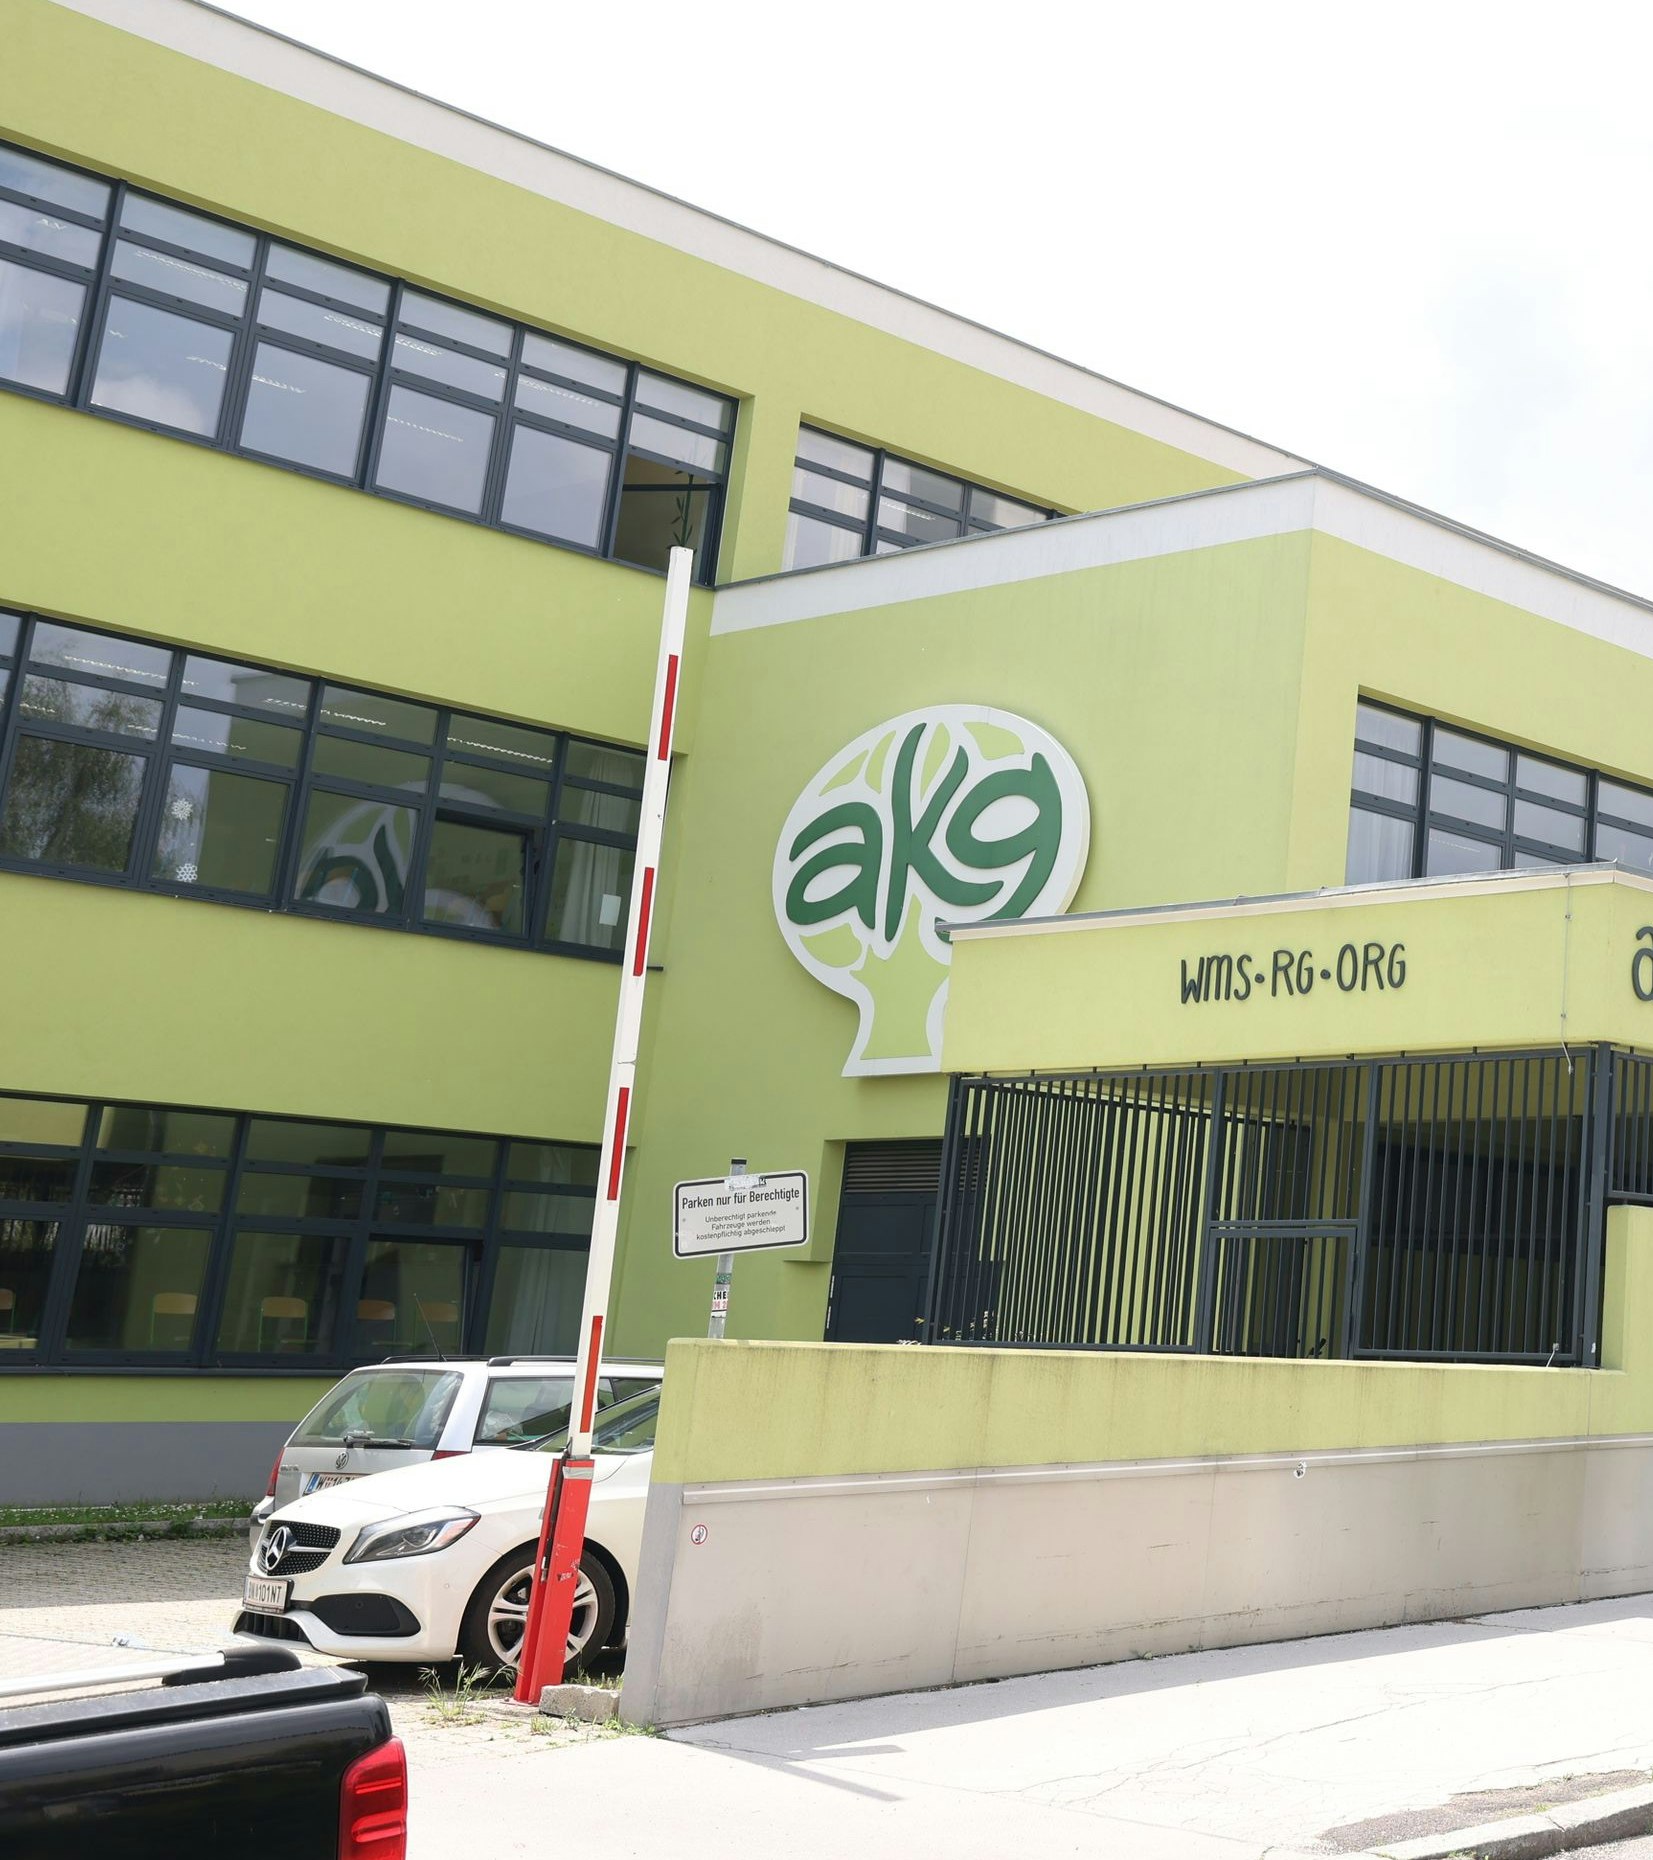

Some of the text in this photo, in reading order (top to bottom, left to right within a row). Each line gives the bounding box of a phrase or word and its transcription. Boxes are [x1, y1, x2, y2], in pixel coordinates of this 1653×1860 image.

[682, 1188, 800, 1209] Parken nur für Berechtigte
[705, 1212, 746, 1223] Unberechtigt
[711, 1219, 771, 1231] Fahrzeuge werden
[696, 1224, 786, 1241] kostenpflichtig abgeschleppt
